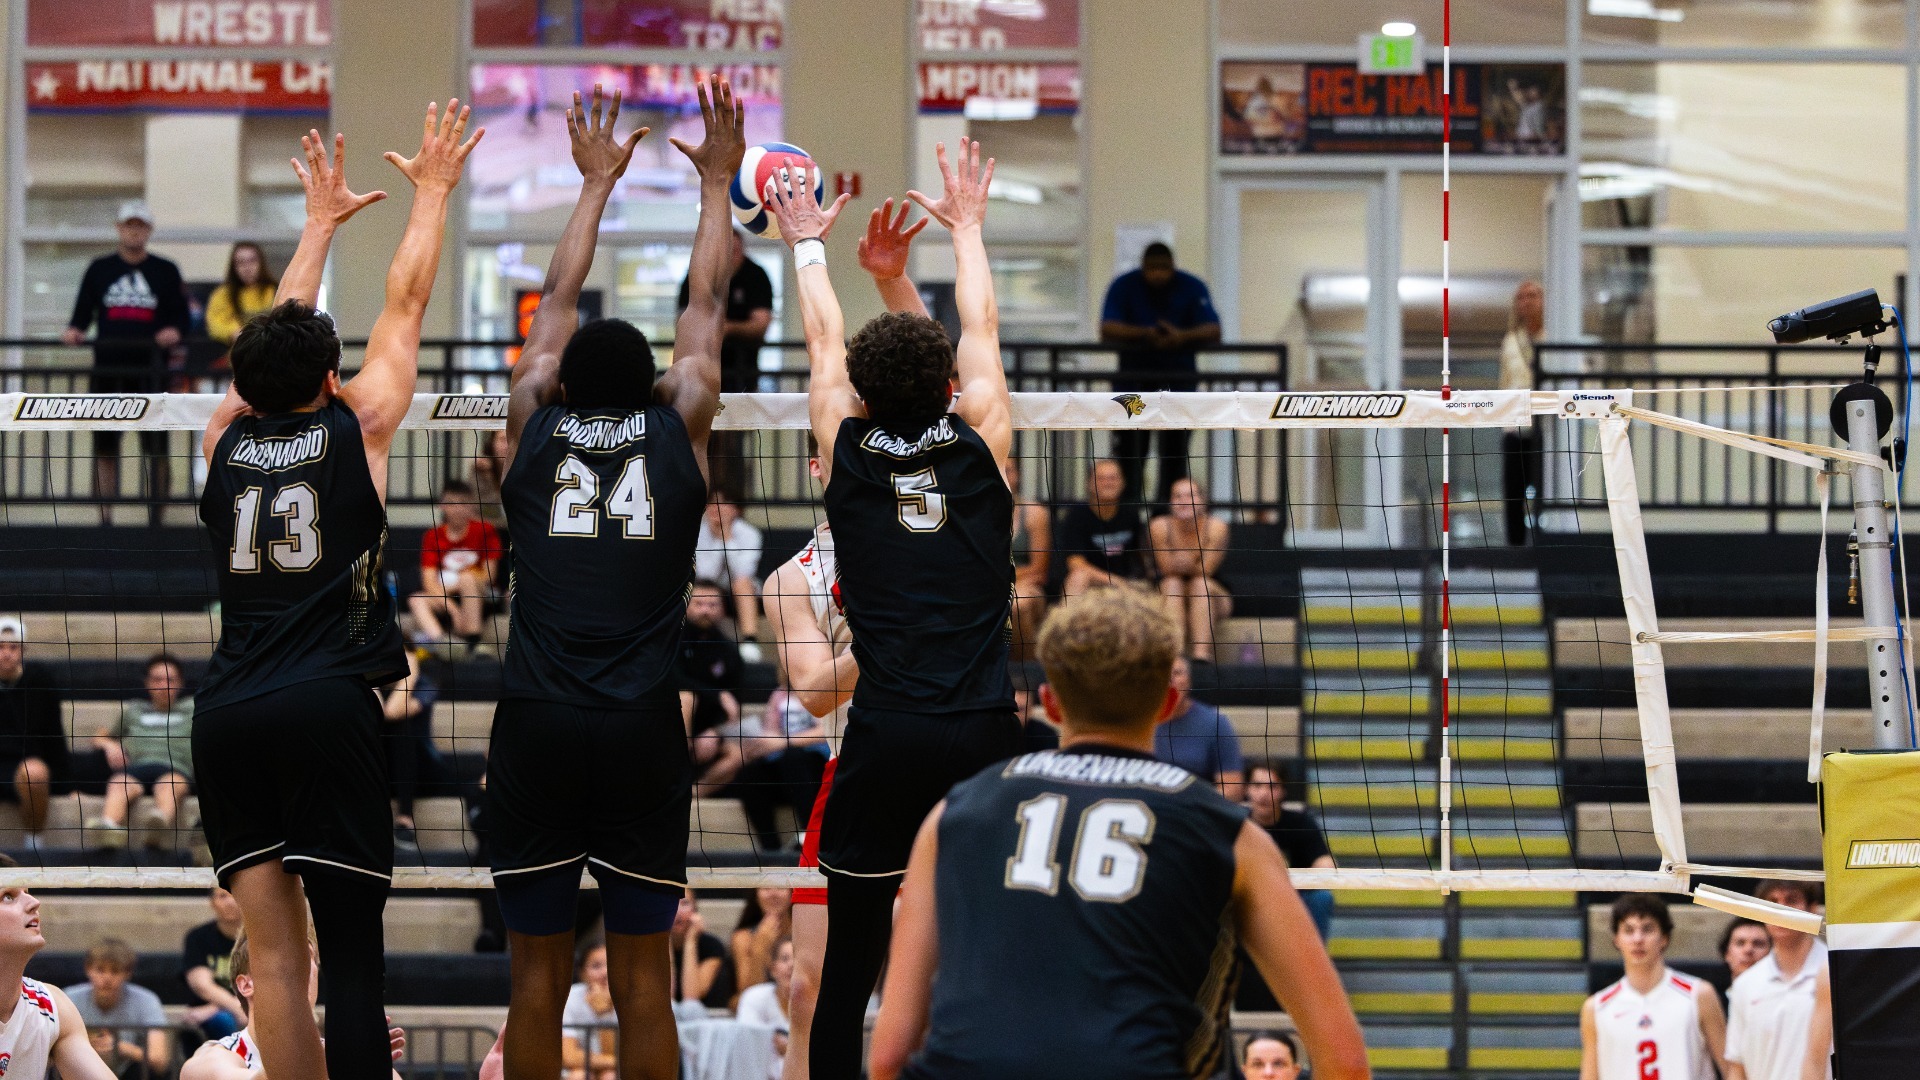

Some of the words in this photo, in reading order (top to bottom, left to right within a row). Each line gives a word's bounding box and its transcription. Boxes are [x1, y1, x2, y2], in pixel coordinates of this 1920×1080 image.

[154, 3, 331, 44] WRESTL
[77, 61, 266, 93] NATIONAL
[1308, 68, 1378, 116] REC
[1385, 68, 1479, 117] HALL
[19, 398, 148, 419] LINDENWOOD
[1275, 396, 1404, 418] LINDENWOOD
[1445, 401, 1467, 409] sports
[549, 454, 655, 540] 24
[891, 466, 948, 532] 5
[230, 481, 322, 573] 13
[1013, 751, 1192, 788] LINDENWOOD
[1004, 792, 1157, 904] 16
[1850, 842, 1920, 866] LINDENWO
[1637, 1040, 1659, 1080] 2
